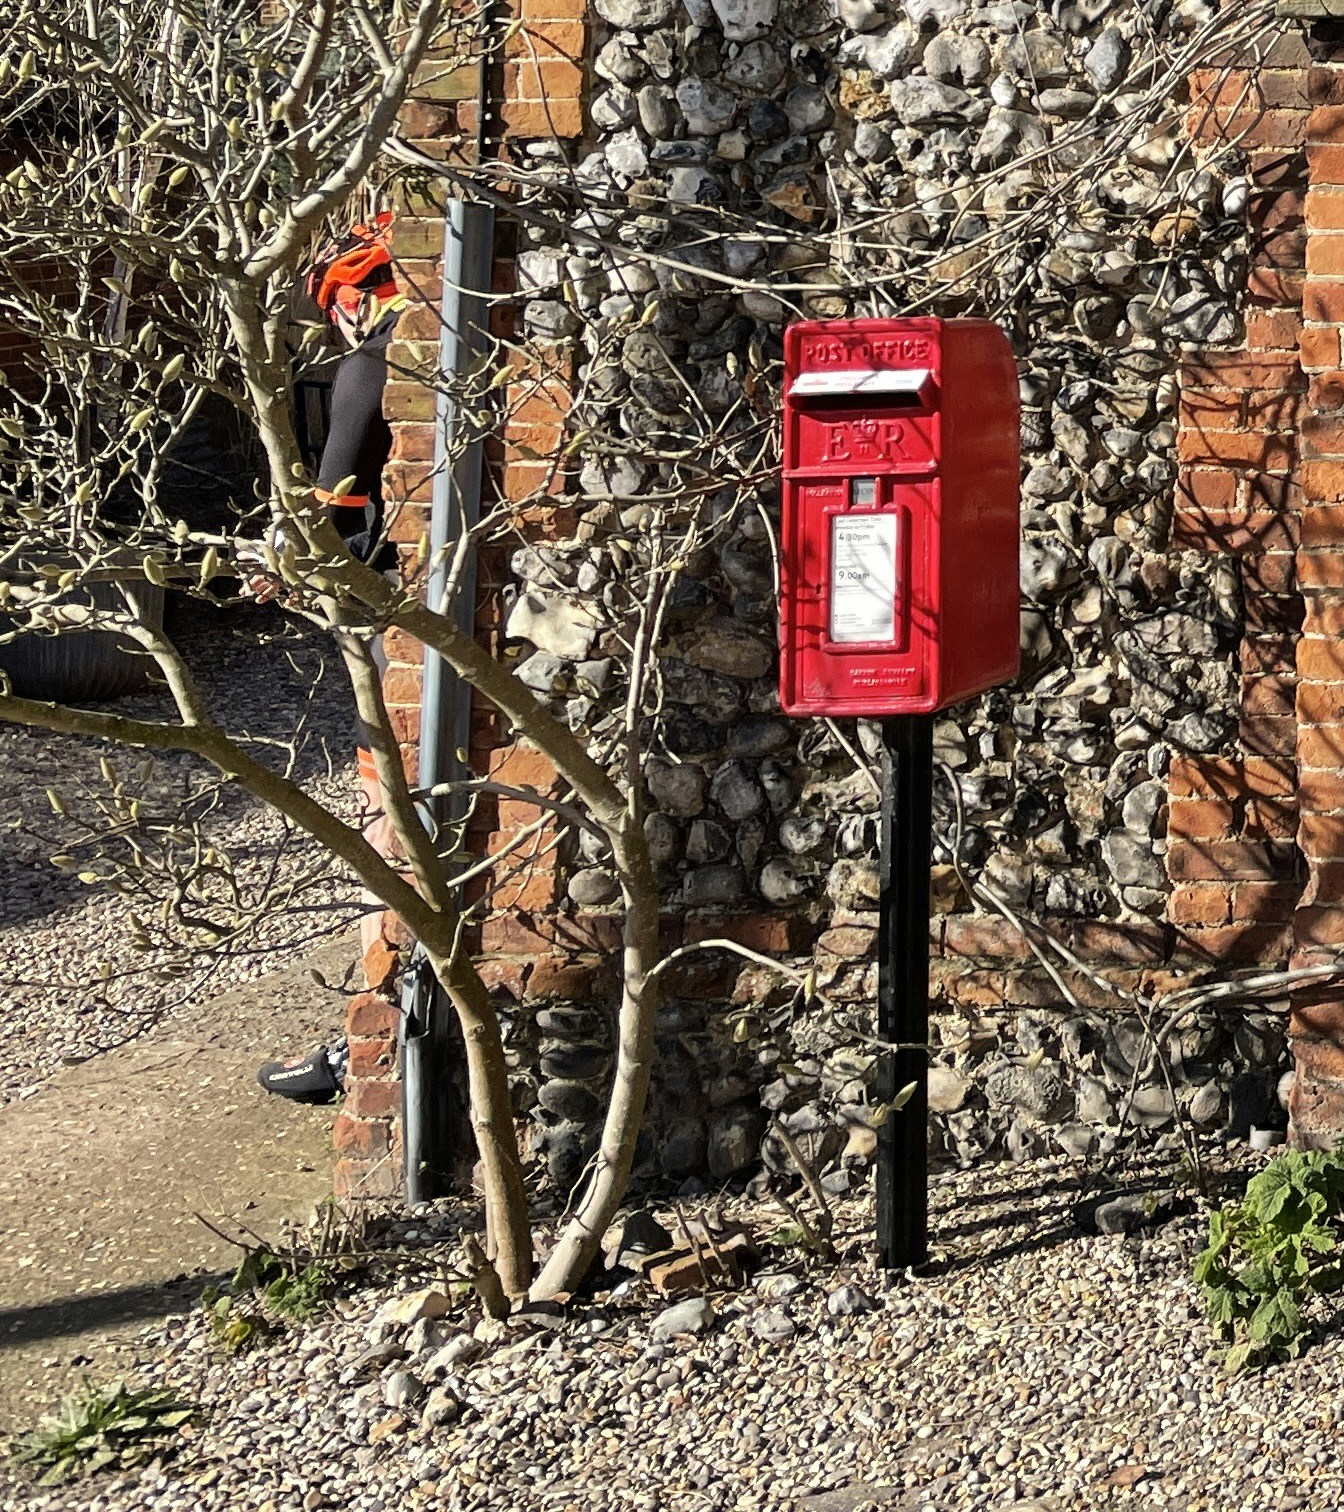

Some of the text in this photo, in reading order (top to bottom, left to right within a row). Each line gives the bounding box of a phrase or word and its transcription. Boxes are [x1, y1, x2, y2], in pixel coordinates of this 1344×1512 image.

[805, 339, 930, 364] POST OFFICE
[822, 421, 851, 463] E
[877, 421, 911, 461] R
